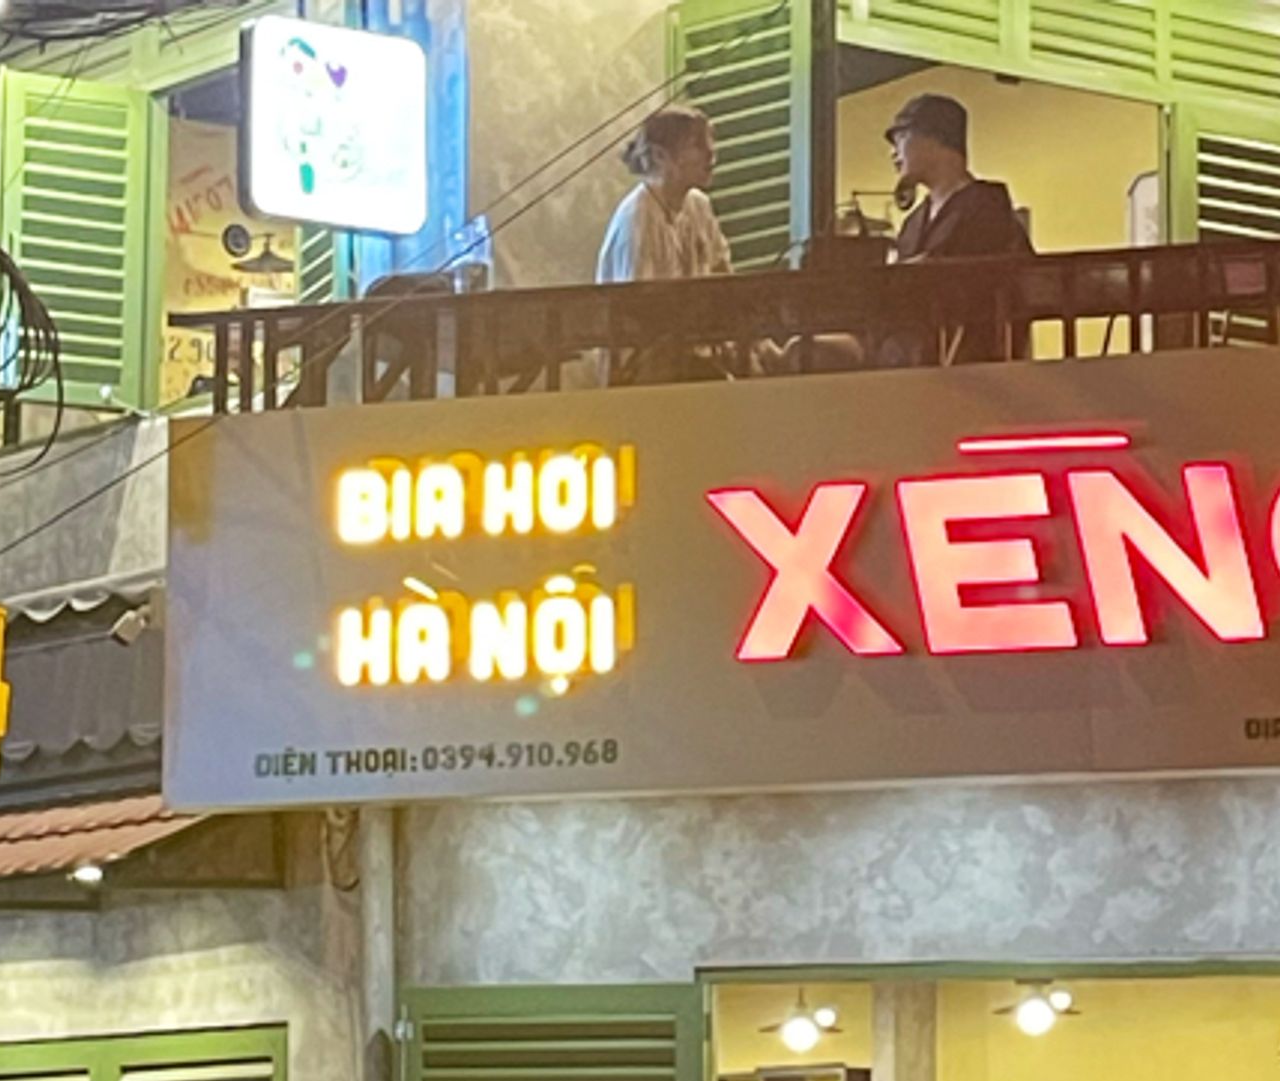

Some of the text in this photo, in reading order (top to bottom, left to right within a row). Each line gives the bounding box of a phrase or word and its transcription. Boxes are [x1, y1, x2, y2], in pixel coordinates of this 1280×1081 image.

[335, 466, 465, 545] BIA
[336, 574, 616, 695] HÀ NỘI
